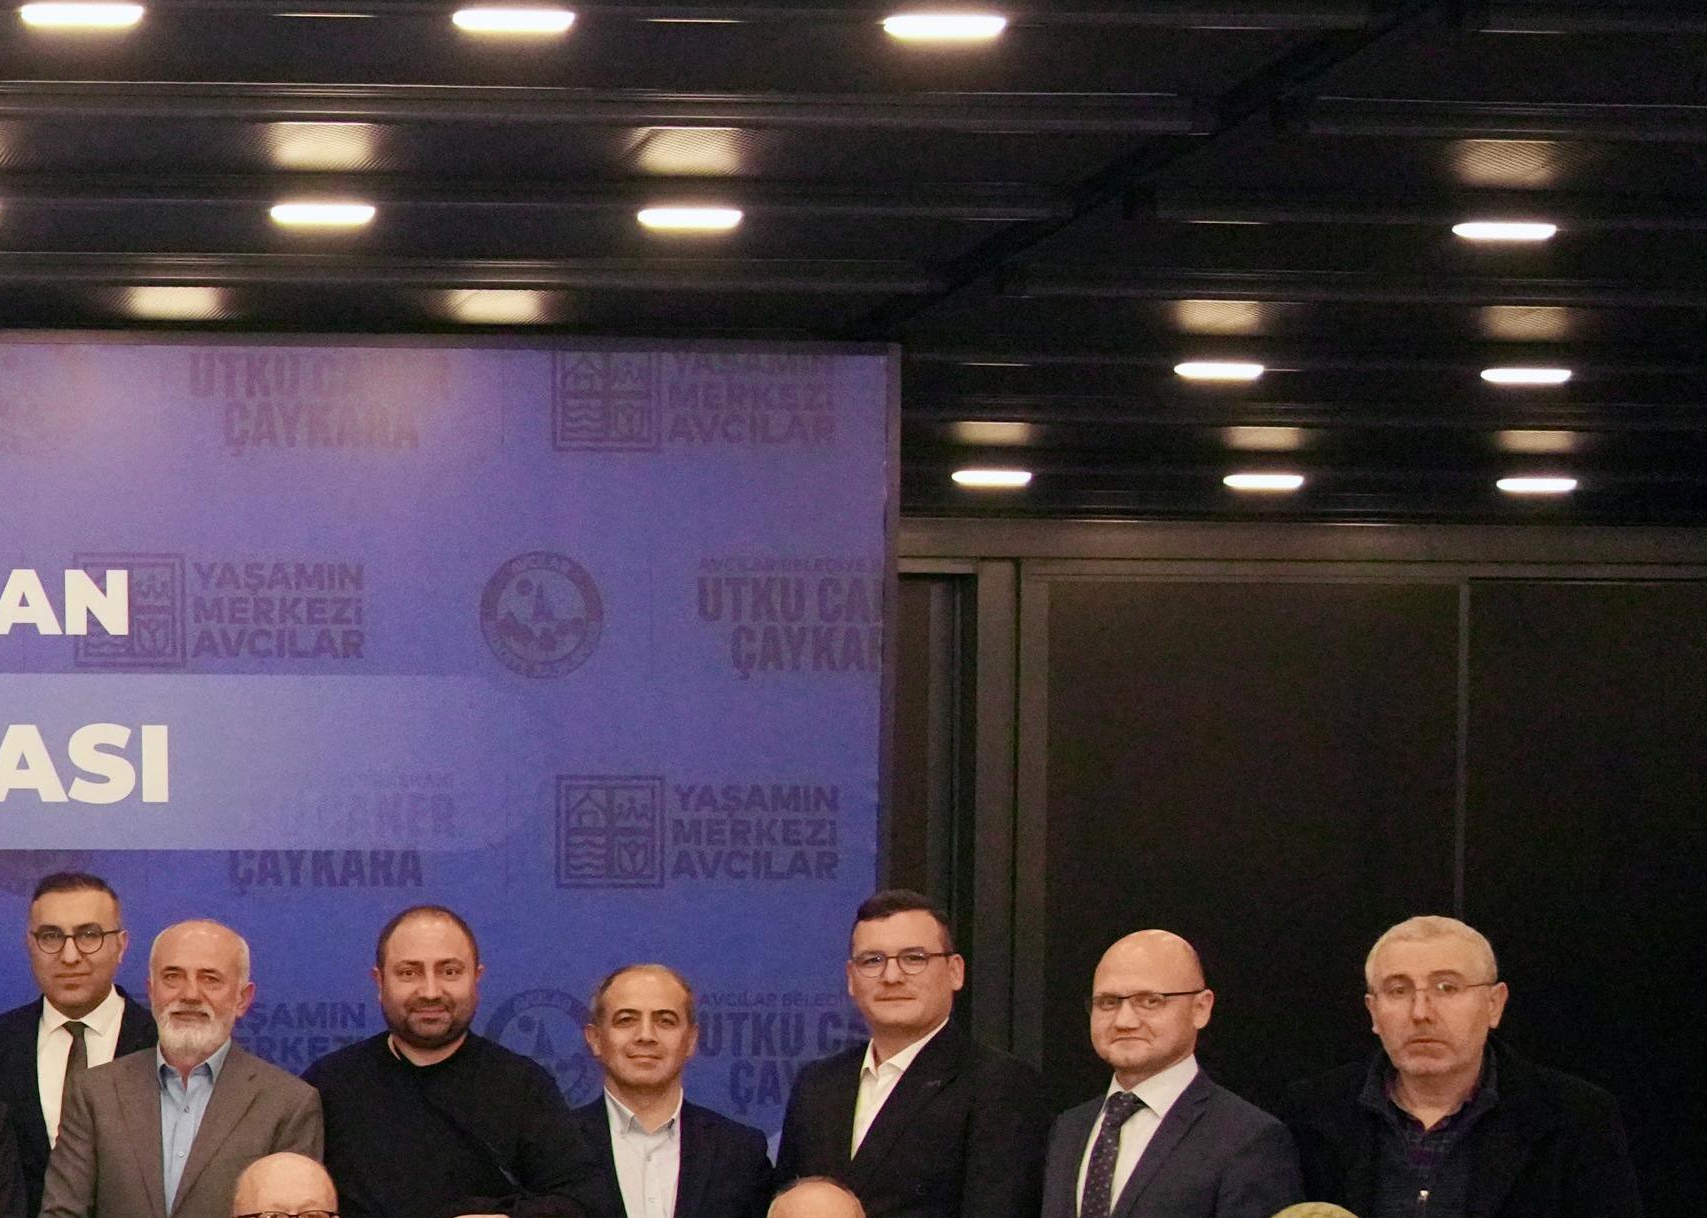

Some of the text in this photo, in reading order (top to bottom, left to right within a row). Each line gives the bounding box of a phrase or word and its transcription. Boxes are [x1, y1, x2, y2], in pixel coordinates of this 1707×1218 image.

[668, 414, 836, 445] AVCILAR
[192, 562, 364, 596] YAŞAMIN
[193, 596, 363, 625] MERKEZİ
[697, 577, 806, 623] UTKU
[191, 628, 365, 659] AVCILAR
[673, 784, 840, 817] YAŞAMIN
[672, 849, 839, 880] AVCILAR
[237, 1001, 366, 1034] ŞAMIN
[698, 1011, 805, 1058] UTKU
